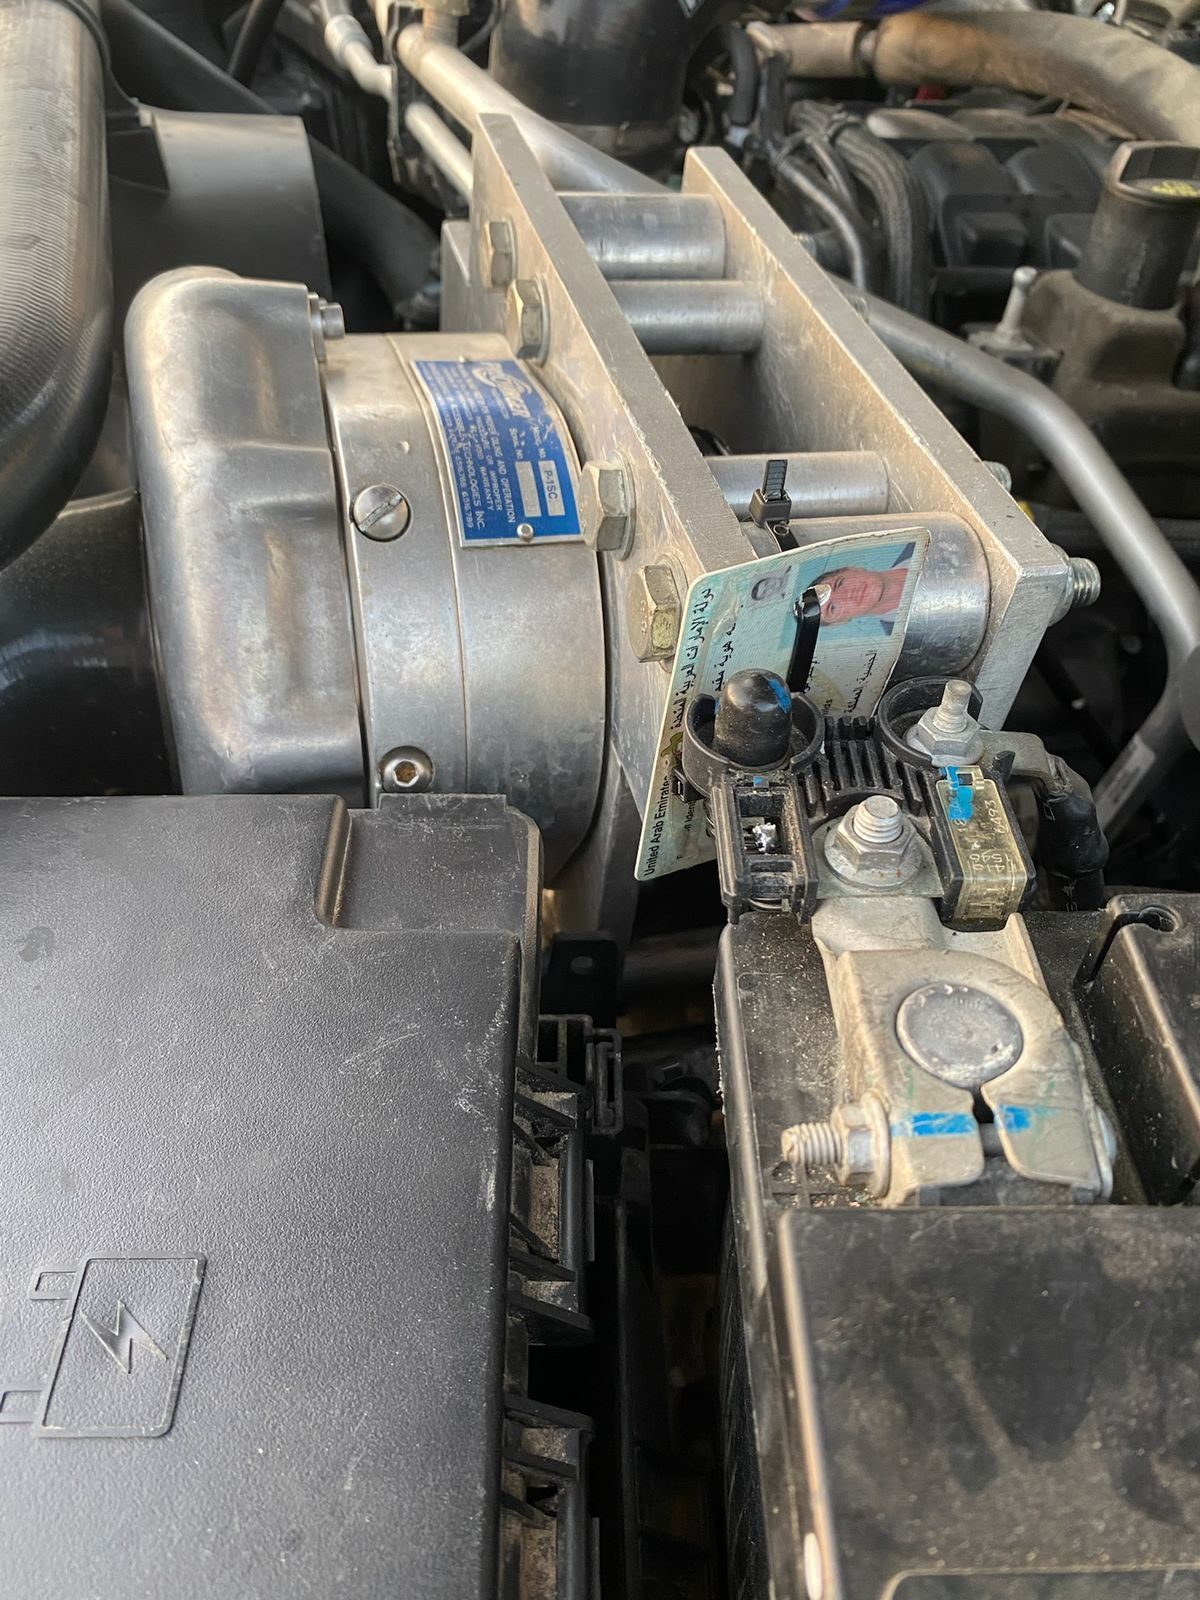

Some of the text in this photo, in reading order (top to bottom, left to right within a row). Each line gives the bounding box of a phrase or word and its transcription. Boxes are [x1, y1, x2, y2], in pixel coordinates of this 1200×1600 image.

[463, 441, 481, 507] TECHNOLOGIES
[480, 466, 494, 511] WARRANTY
[501, 478, 516, 523] OPERATION
[693, 588, 714, 614] دولة
[650, 820, 664, 847] Arab
[644, 846, 659, 876] United
